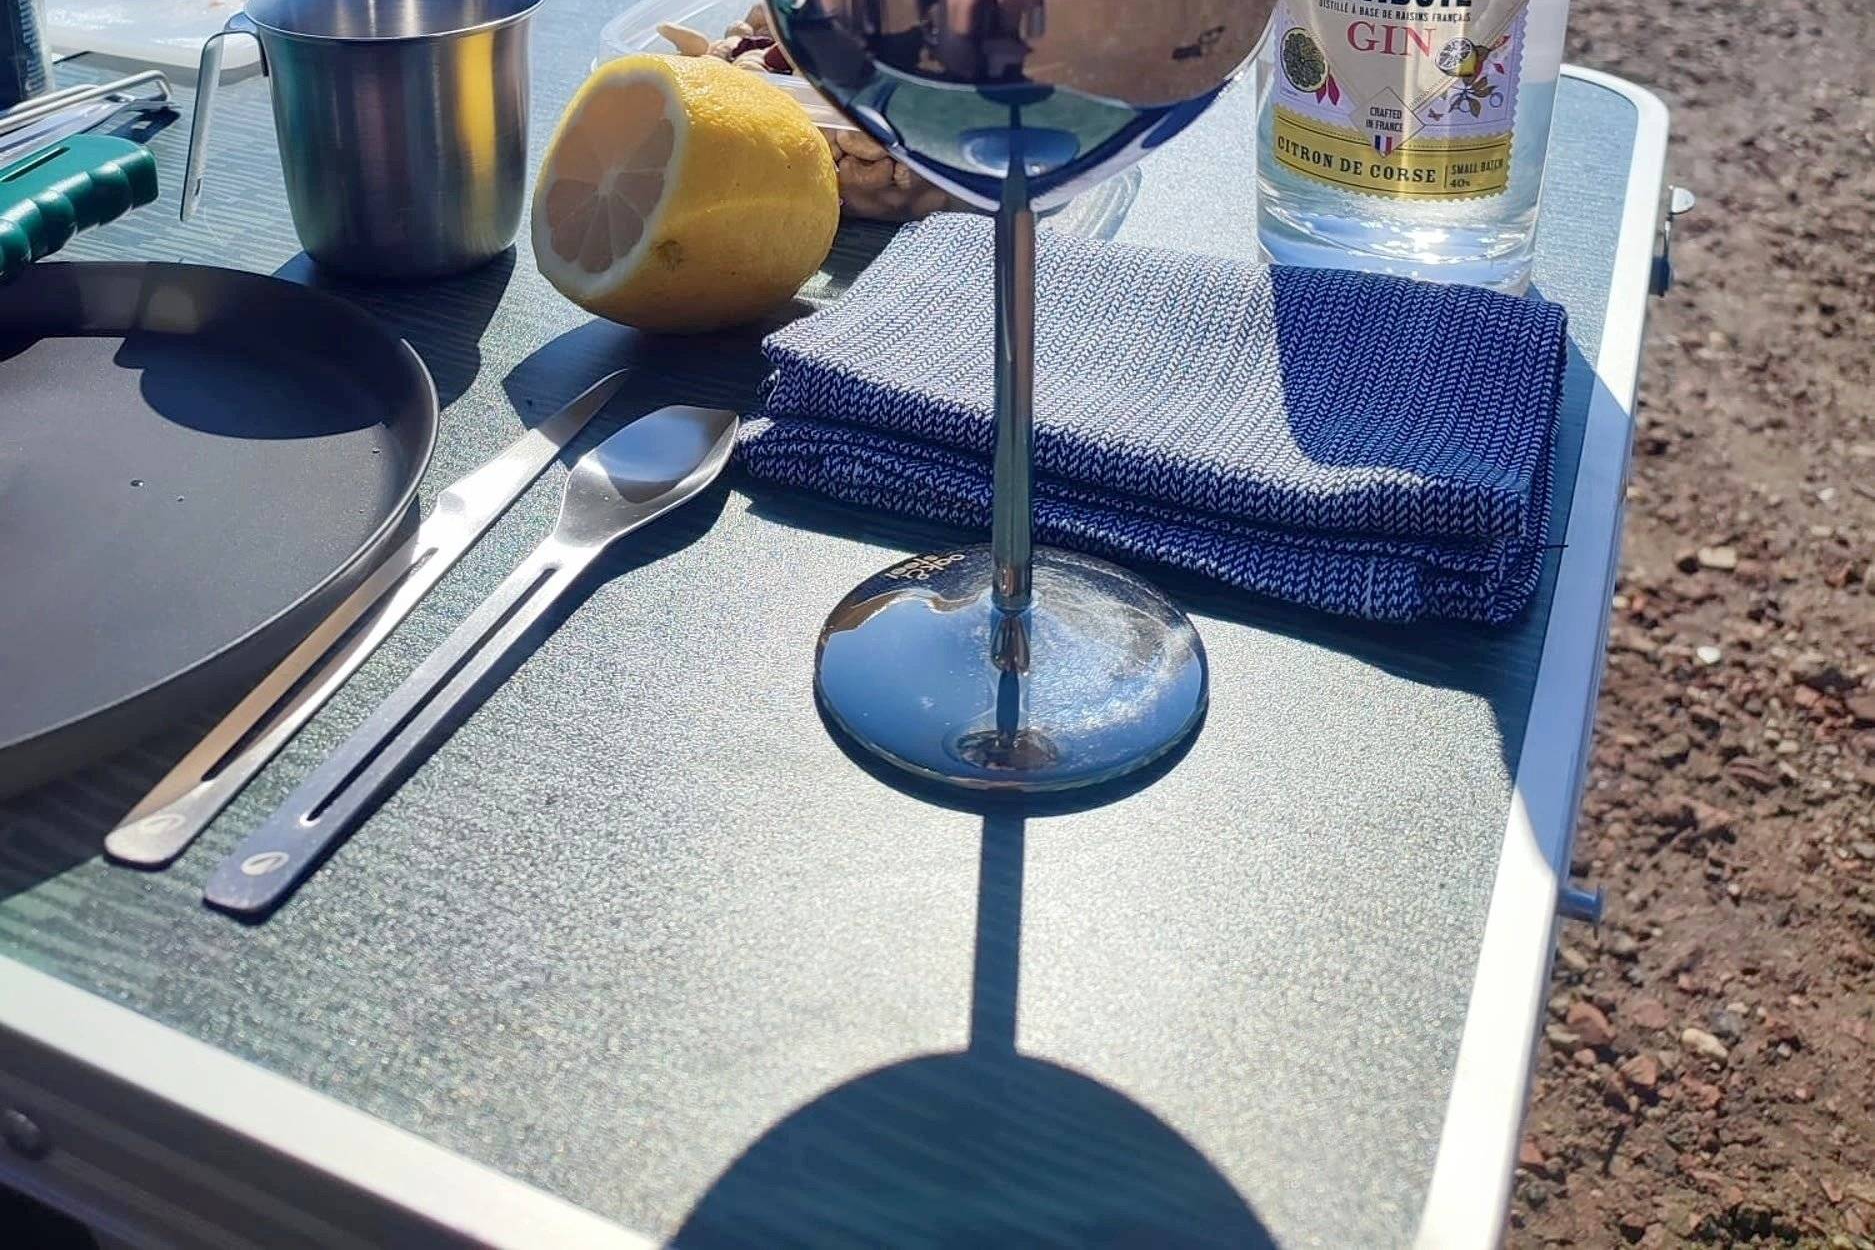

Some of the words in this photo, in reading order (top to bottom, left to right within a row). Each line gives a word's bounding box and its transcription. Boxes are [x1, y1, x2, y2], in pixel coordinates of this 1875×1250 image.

[1359, 6, 1380, 18] BASE
[1382, 9, 1393, 20] DE
[1396, 10, 1428, 22] RAISINS
[1347, 20, 1437, 57] GIN
[1369, 106, 1402, 120] CRAFTED
[1366, 119, 1374, 128] IN
[1375, 120, 1403, 133] FRANCE
[1277, 136, 1334, 169] CITRON
[1340, 157, 1363, 176] DE
[1369, 164, 1437, 184] CORSE
[1451, 161, 1478, 175] SMALL
